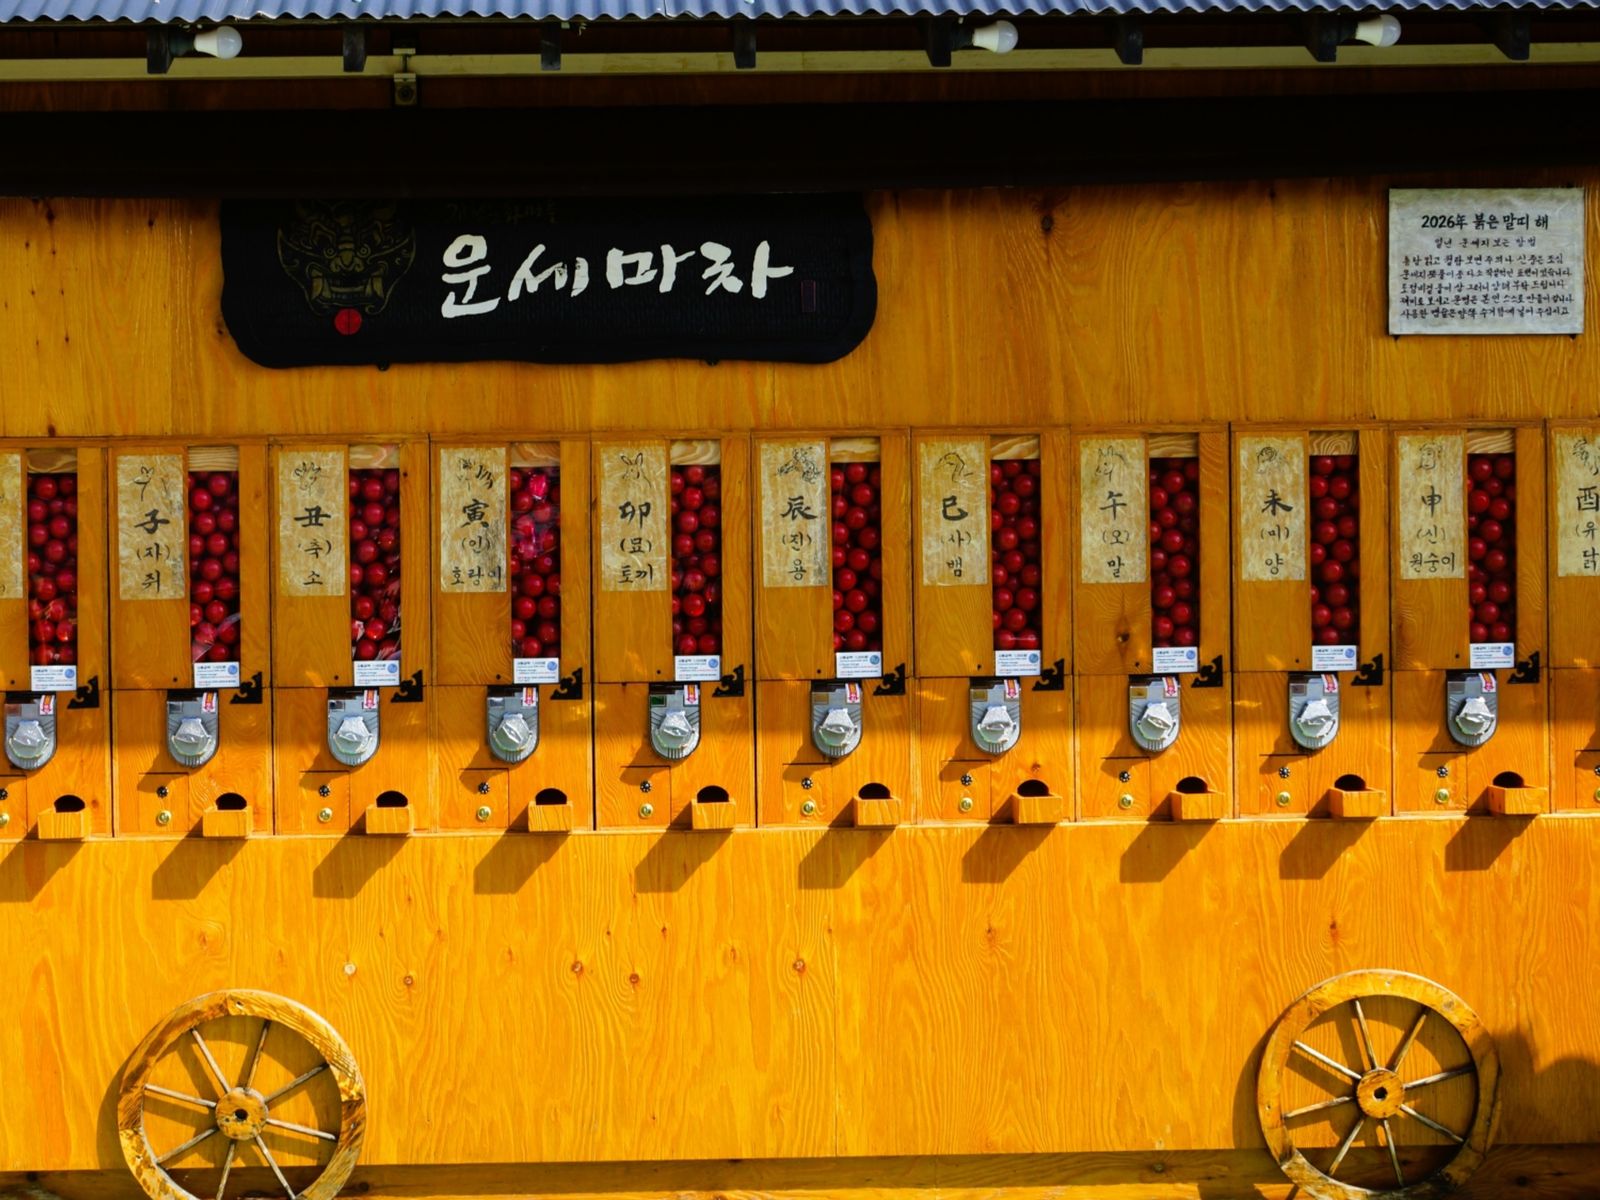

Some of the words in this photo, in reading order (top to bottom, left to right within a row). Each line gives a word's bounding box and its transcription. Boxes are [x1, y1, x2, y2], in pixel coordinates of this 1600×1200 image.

[1421, 214, 1468, 230] 2026年
[1473, 213, 1499, 230] 붉은
[1503, 213, 1529, 230] 말띠
[1535, 214, 1548, 229] 해
[1493, 238, 1510, 248] 보는
[1516, 236, 1536, 247] 방법
[441, 233, 795, 319] 운세마차
[780, 496, 818, 520] 辰
[1100, 491, 1127, 520] 午
[1261, 489, 1293, 516] 未
[1421, 486, 1442, 517] 申
[1577, 486, 1600, 512] 酉
[134, 509, 170, 534] 子
[294, 505, 331, 527] 丑
[461, 499, 489, 528] 寅
[619, 501, 651, 529] 卯
[782, 532, 812, 551] (진)
[941, 529, 971, 547] (사)
[1102, 530, 1130, 545] (오)
[1260, 525, 1290, 541] (미)
[1416, 525, 1446, 544] (신)
[137, 543, 170, 562] (자)
[298, 539, 332, 558] 축)
[461, 536, 491, 553] (인)
[620, 538, 652, 553] (묘)
[789, 559, 807, 580] 용
[946, 557, 963, 577] 뱀
[1107, 555, 1125, 578] 말
[1265, 553, 1284, 575] 양
[1409, 552, 1455, 573] 원숭이
[1583, 547, 1599, 571] 닭
[142, 570, 161, 593] 쥐
[304, 571, 323, 585] 소
[451, 566, 502, 587] 호랑이
[618, 564, 653, 583] 토끼
